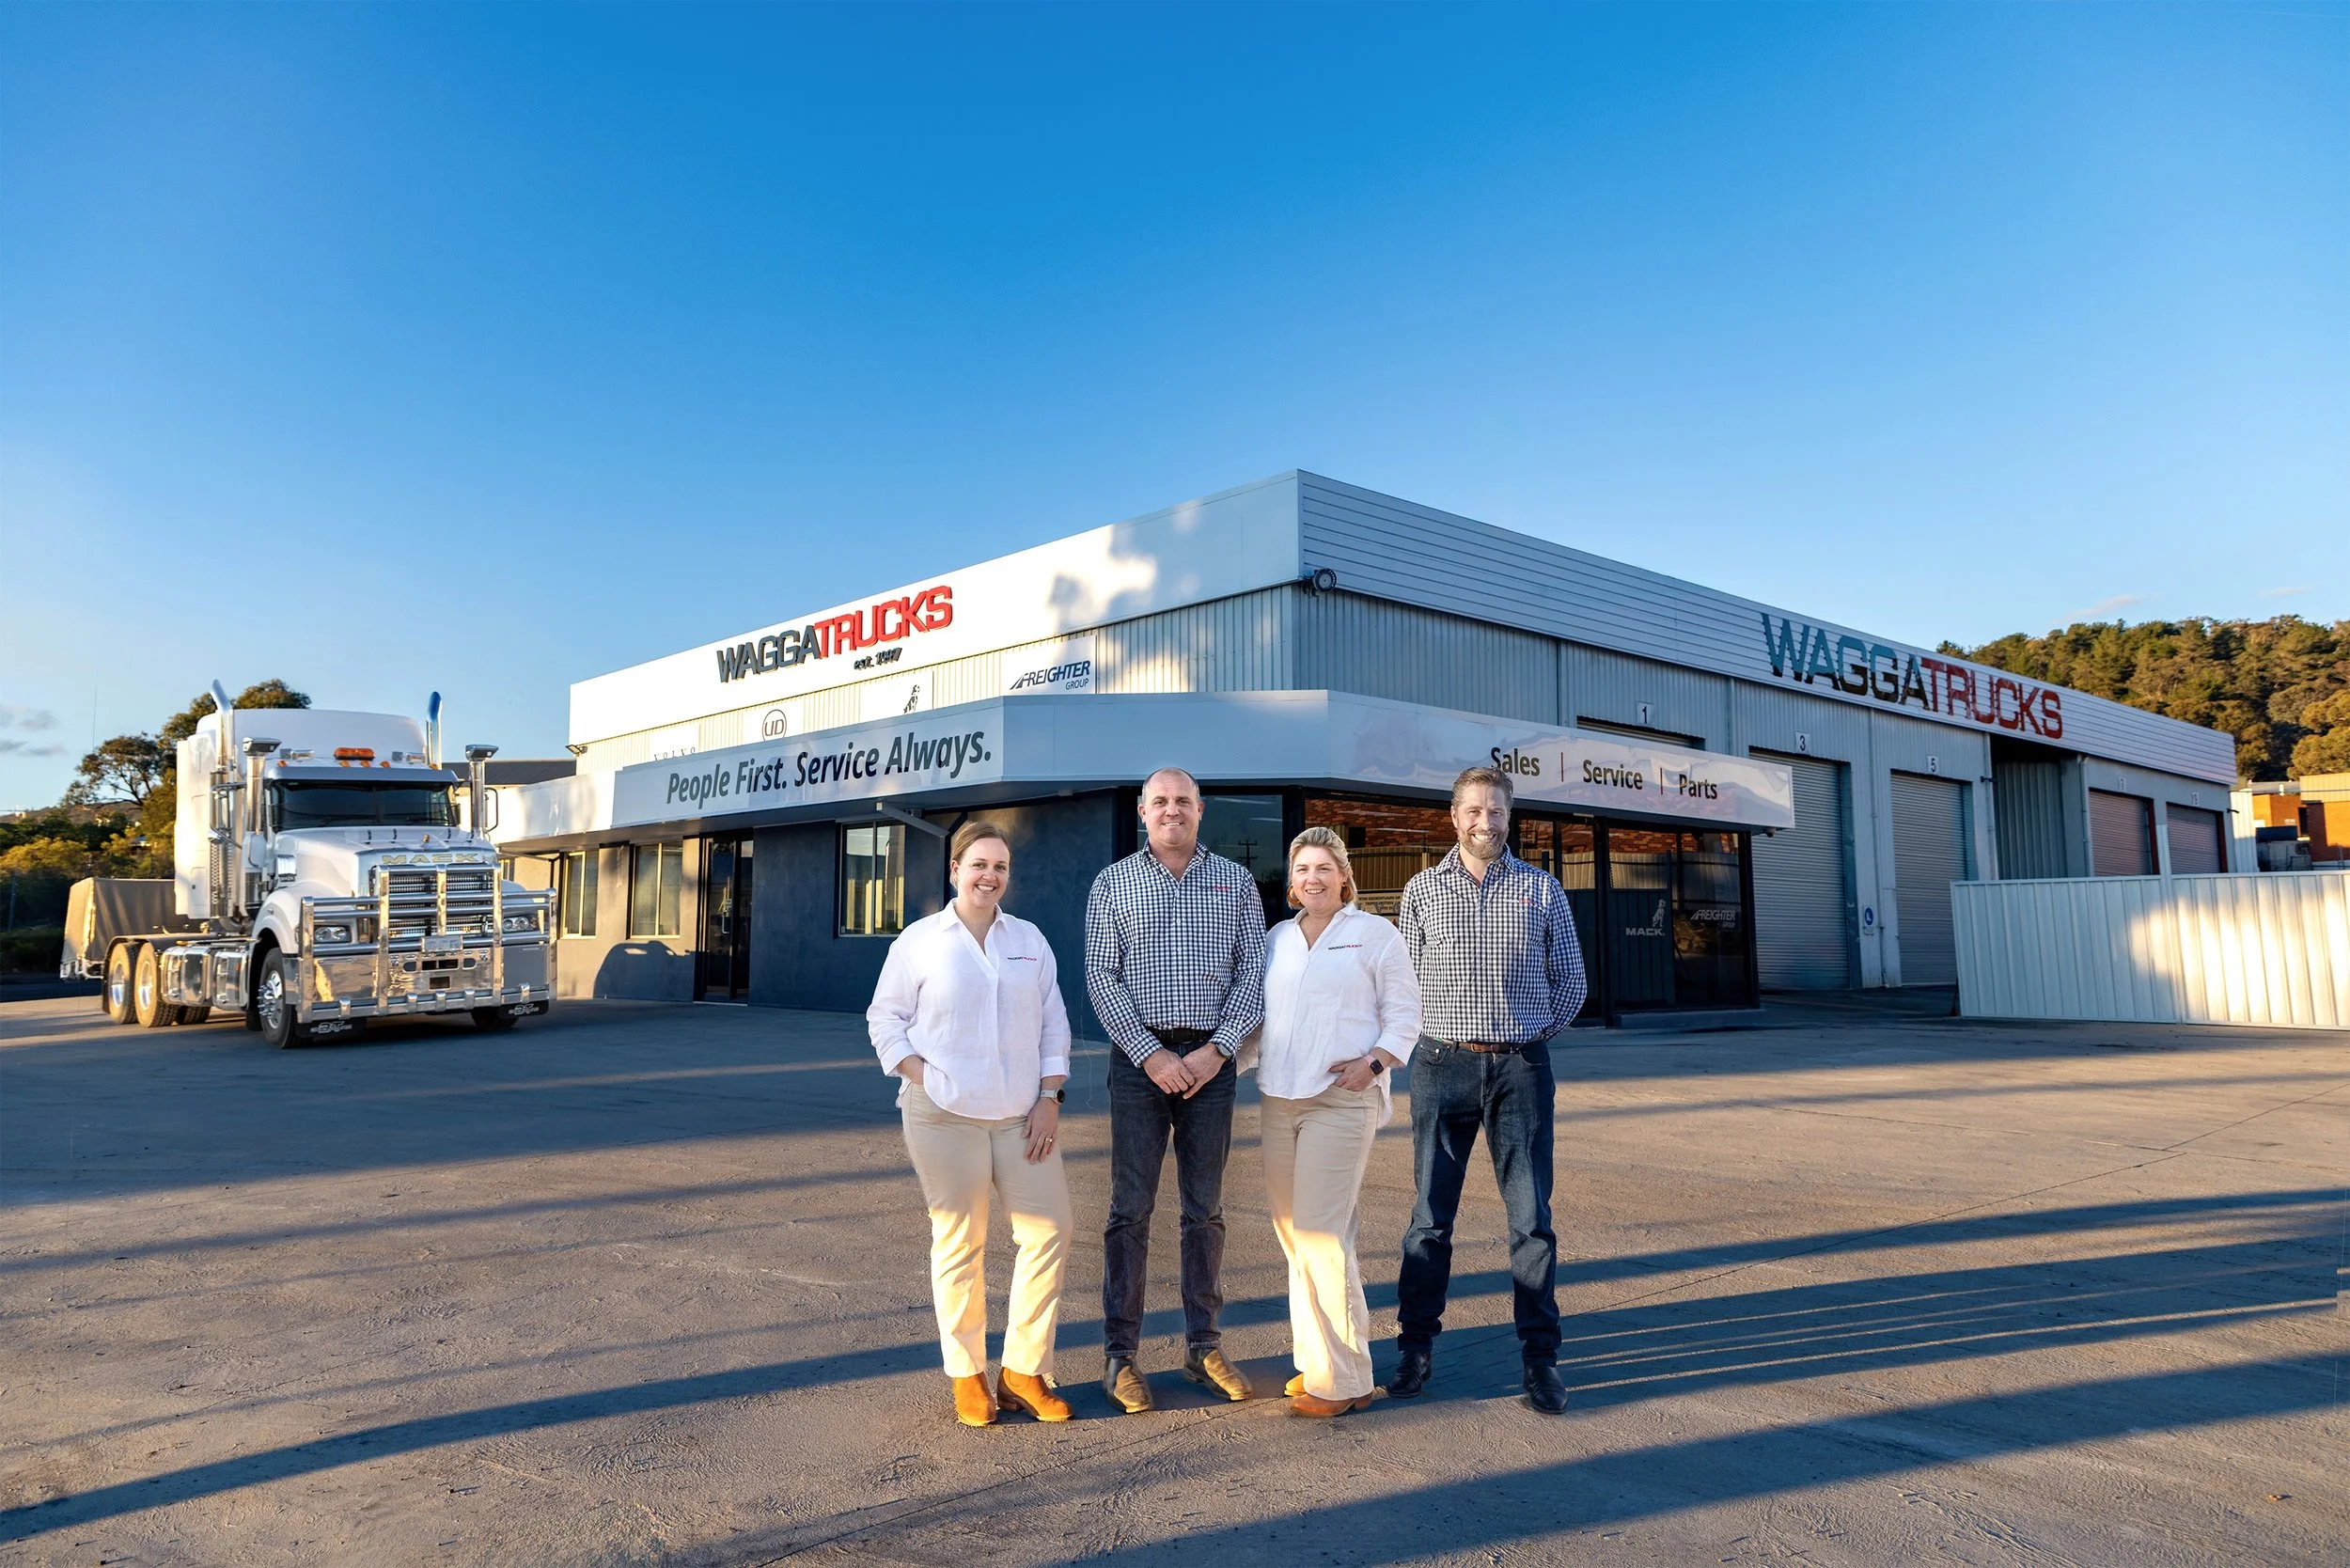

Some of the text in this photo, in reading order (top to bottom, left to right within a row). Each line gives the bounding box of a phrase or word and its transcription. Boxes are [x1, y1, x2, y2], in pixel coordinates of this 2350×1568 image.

[716, 585, 952, 682] WAGGATRUCKS
[1010, 660, 1090, 690] FREIGHTER
[1065, 678, 1089, 690] GROUP
[1762, 613, 2062, 739] WAGGATRUCKS
[1641, 706, 1648, 724] 1
[764, 718, 784, 737] UD
[1799, 734, 1807, 752] 3
[666, 729, 991, 809] People First. Service Always.
[1490, 746, 1717, 800] Sales Service Parts
[1931, 758, 1936, 772] 5
[382, 854, 478, 864] MACK
[1692, 909, 1735, 920] FREIGHTER
